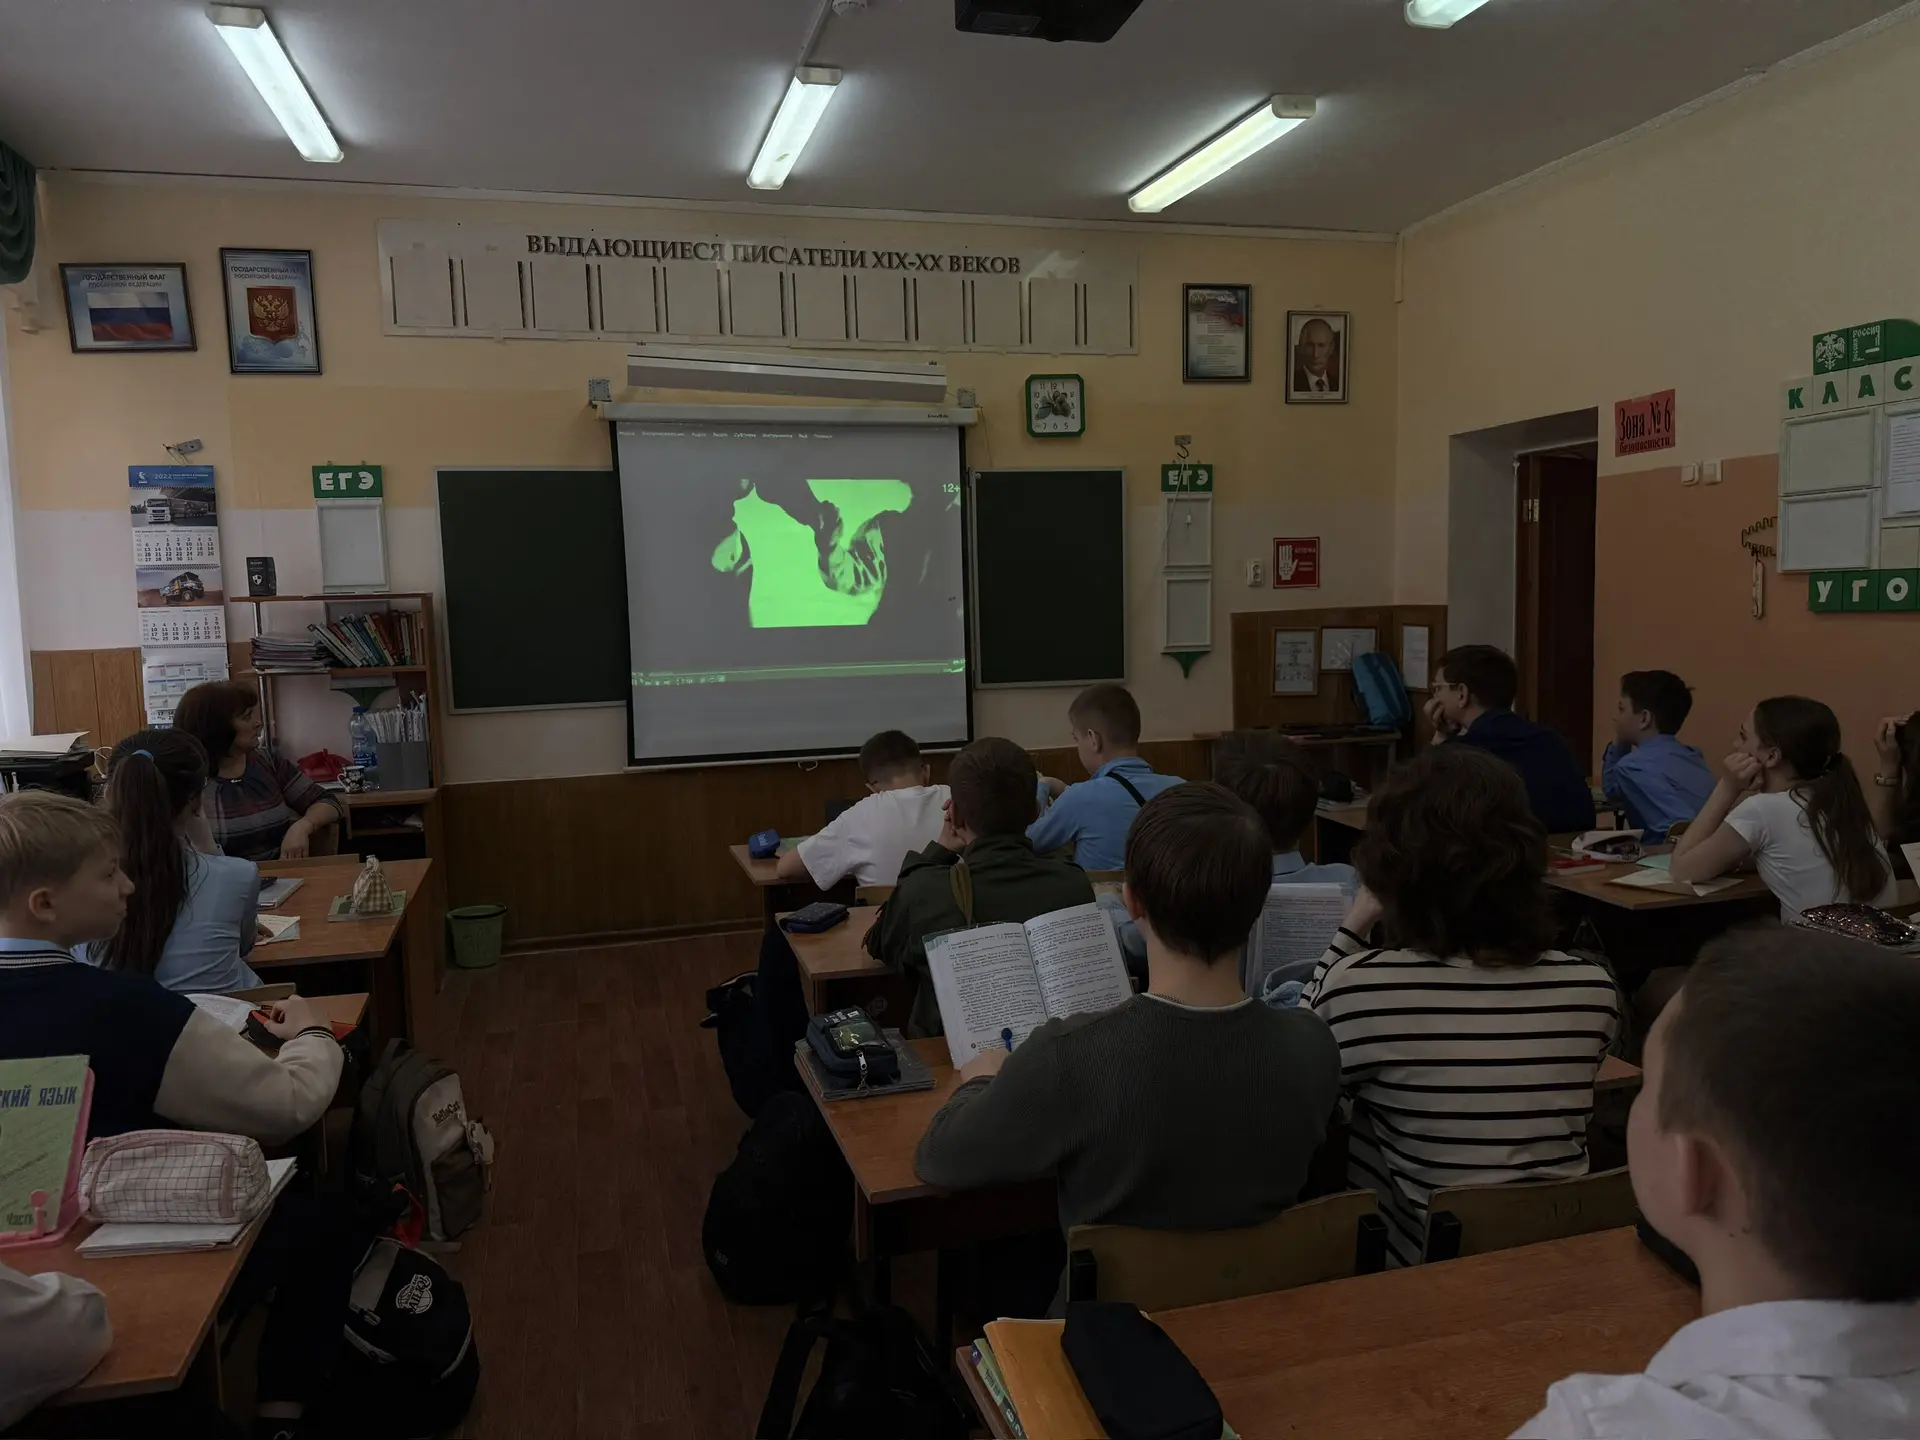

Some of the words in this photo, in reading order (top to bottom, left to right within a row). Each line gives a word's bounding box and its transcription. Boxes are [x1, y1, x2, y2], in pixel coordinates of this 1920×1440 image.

[526, 235, 725, 262] ВЫДАЮЩИЕСЯ
[732, 244, 868, 269] ПИСАТЕЛИ
[872, 251, 943, 271] XIX-XX
[949, 255, 1021, 274] ВЕКОВ
[83, 272, 148, 281] ГОСУДАРСТВЕННЫЙ
[149, 273, 166, 281] ФЛАГ
[1619, 407, 1645, 441] Зона
[1648, 400, 1661, 435] №
[1664, 397, 1671, 432] 6
[1619, 437, 1670, 454] безопасности
[319, 471, 374, 490] ЕГЭ
[942, 483, 960, 493] 12+
[37, 1086, 78, 1106] ЯЗЫК
